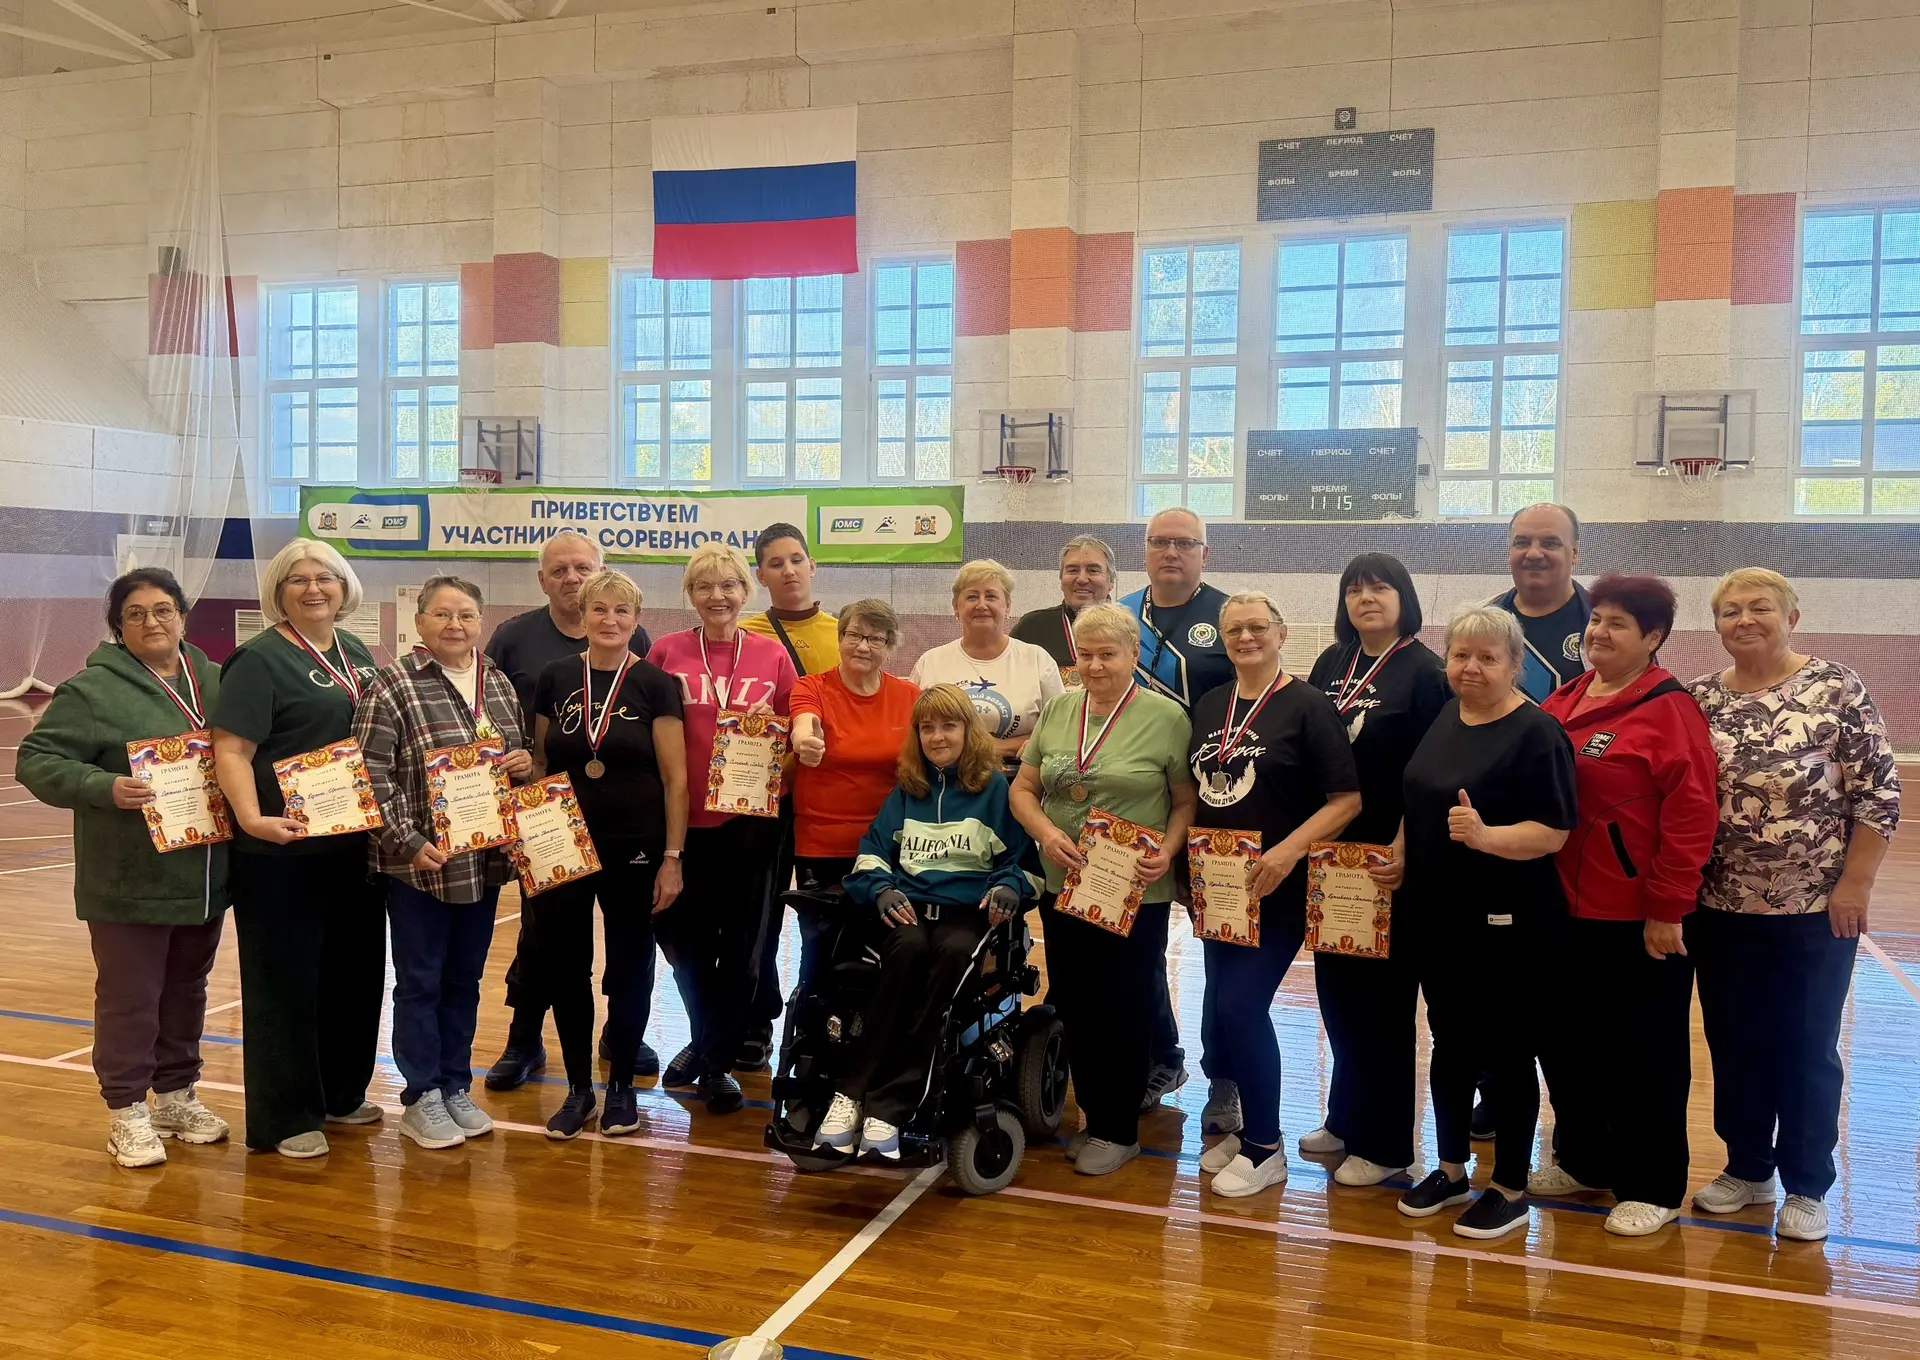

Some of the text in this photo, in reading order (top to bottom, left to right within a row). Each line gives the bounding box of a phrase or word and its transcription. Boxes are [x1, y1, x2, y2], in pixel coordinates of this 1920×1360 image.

[1277, 132, 1414, 150] СЧЕТ ПЕРИОД СЧЕТ
[1267, 168, 1421, 186] ФОЛЫ ВРЕМЯ ФОЛЫ
[1257, 447, 1397, 457] СЧЕТ ПЕРИОД СЧЕТ
[1311, 485, 1348, 493] ВРЕМЯ
[1259, 493, 1289, 501] ФОЛЫ
[1371, 492, 1402, 500] ФОЛЫ
[531, 500, 699, 523] ПРИВЕТСТВУЕМ
[384, 516, 405, 526] ЮМС
[834, 519, 861, 529] ЮМС
[598, 528, 763, 550] СОРЕВНОВАН
[454, 771, 481, 781] ГРАМОТА
[525, 808, 552, 820] ГРАМОТА
[1104, 844, 1130, 859] ГРАМОТА
[1211, 859, 1236, 867] ГРАМОТА
[1335, 872, 1364, 880] ГРАМОТА
